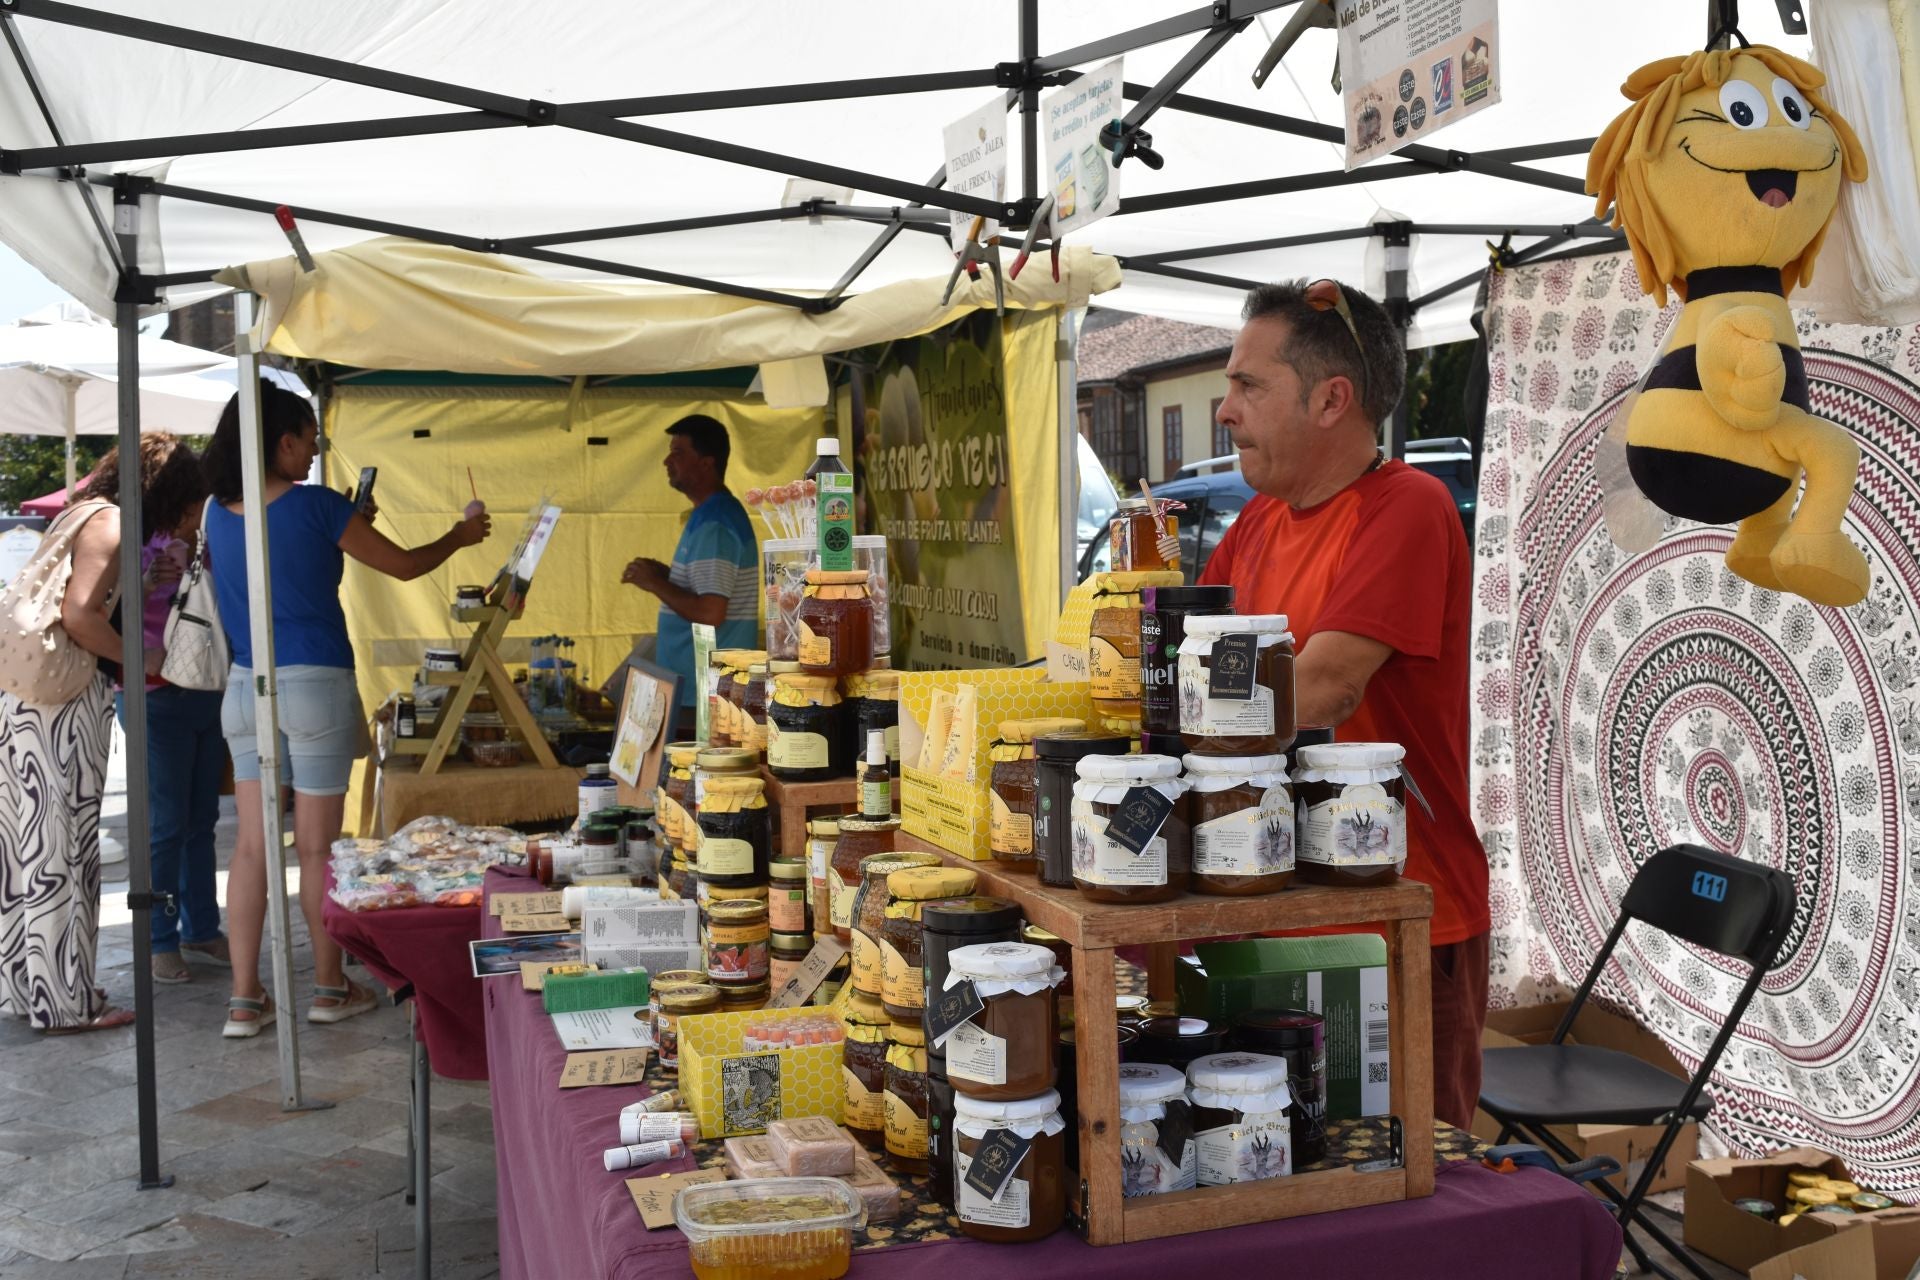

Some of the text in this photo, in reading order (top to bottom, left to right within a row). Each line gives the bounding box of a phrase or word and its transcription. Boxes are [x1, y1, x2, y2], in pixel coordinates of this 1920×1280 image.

[1340, 3, 1357, 29] Miel
[985, 136, 1003, 155] JALEA
[908, 519, 920, 540] DE
[920, 519, 951, 541] FRUTA
[962, 520, 1001, 544] PLANTA
[898, 583, 933, 620] campo
[935, 588, 944, 613] a
[965, 590, 998, 621] casa
[1142, 625, 1160, 635] taste
[920, 630, 953, 654] Servicio
[970, 640, 1016, 666] domicilio
[1224, 638, 1247, 648] Premios
[1696, 874, 1724, 899] 111
